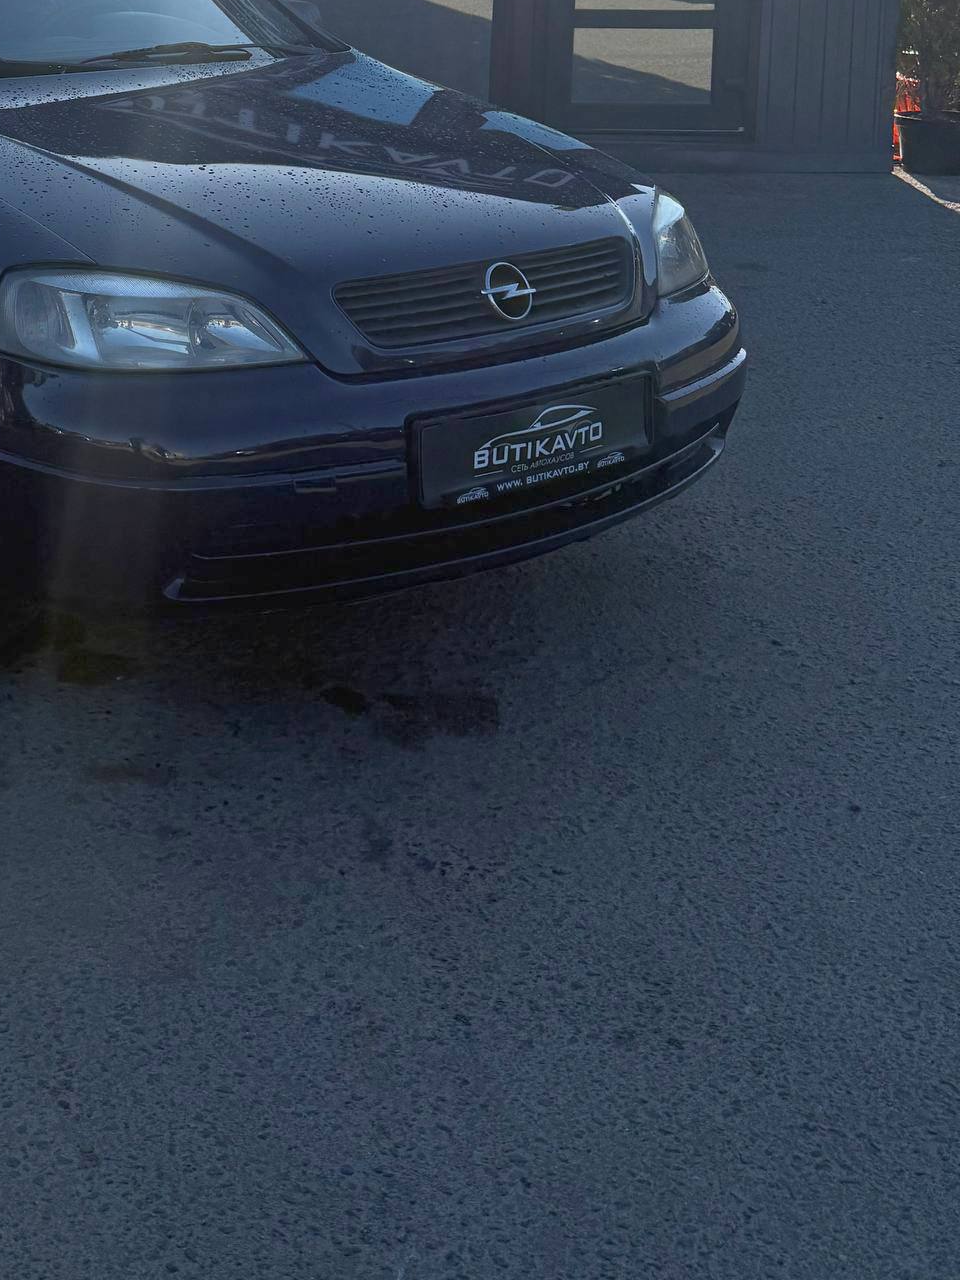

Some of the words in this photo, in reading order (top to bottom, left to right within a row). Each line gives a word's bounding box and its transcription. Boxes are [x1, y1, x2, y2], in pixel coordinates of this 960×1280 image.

[473, 421, 604, 470] BUTIKAVTO
[496, 479, 524, 492] WWW.
[526, 460, 591, 485] BUTIKAVTO.BY
[510, 462, 530, 474] СЕТЬ
